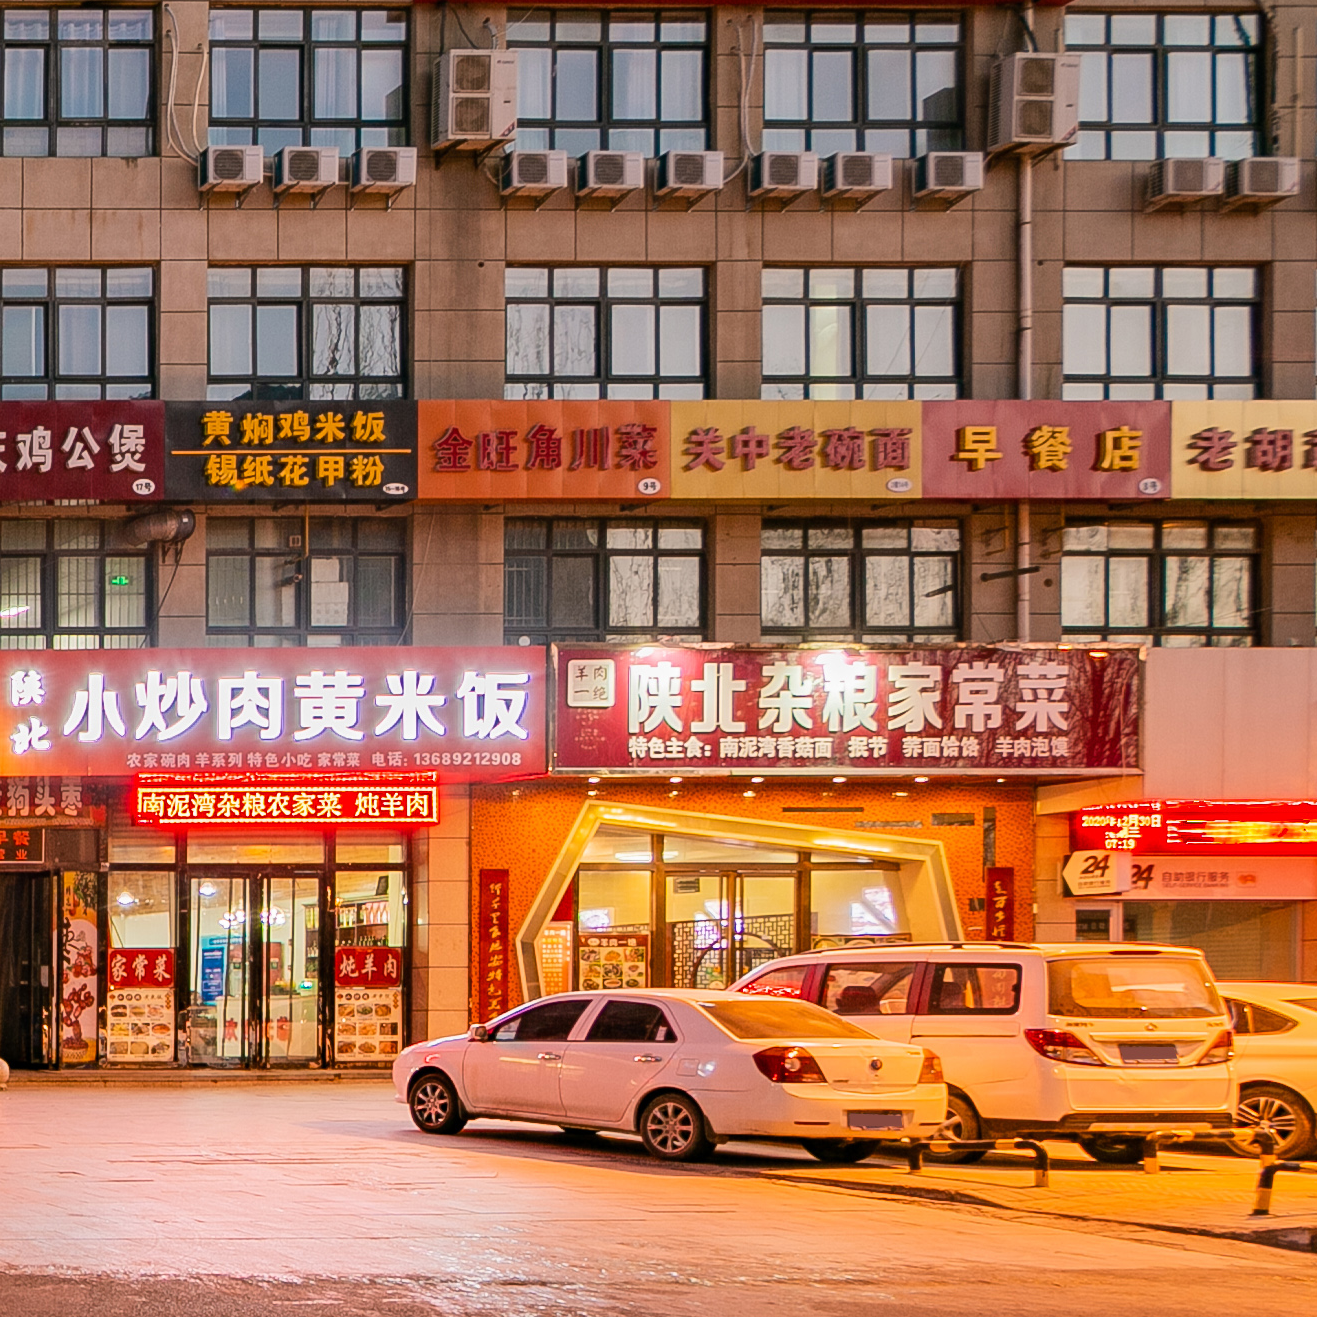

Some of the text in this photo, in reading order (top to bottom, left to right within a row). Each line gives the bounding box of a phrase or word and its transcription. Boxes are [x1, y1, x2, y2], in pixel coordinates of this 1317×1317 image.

[201, 409, 387, 448] 黄焖鸡米饭
[434, 422, 659, 472] 金旺角川菜
[683, 425, 913, 472] 关中老碗面
[949, 424, 1144, 472] 早餐店
[202, 455, 386, 488] 锡纸花甲粉
[8, 668, 52, 755] 陕北
[62, 668, 532, 743] 小炒肉黄米饭
[627, 660, 1070, 734] 陕北杂粮家常菜
[126, 752, 191, 769] 农家碗肉
[195, 752, 243, 769] 羊系列
[247, 752, 314, 769] 特色小吃
[317, 752, 361, 768] 家常菜
[413, 751, 522, 767] 13689212908
[719, 736, 834, 759] 南泥湾香菇面
[995, 737, 1069, 759] 羊肉泡馍
[141, 791, 431, 819] 南泥湾杂粮农家菜 炖羊肉
[1080, 854, 1111, 878] 24
[110, 953, 172, 983] 家常菜
[337, 952, 398, 981] 炖羊肉
